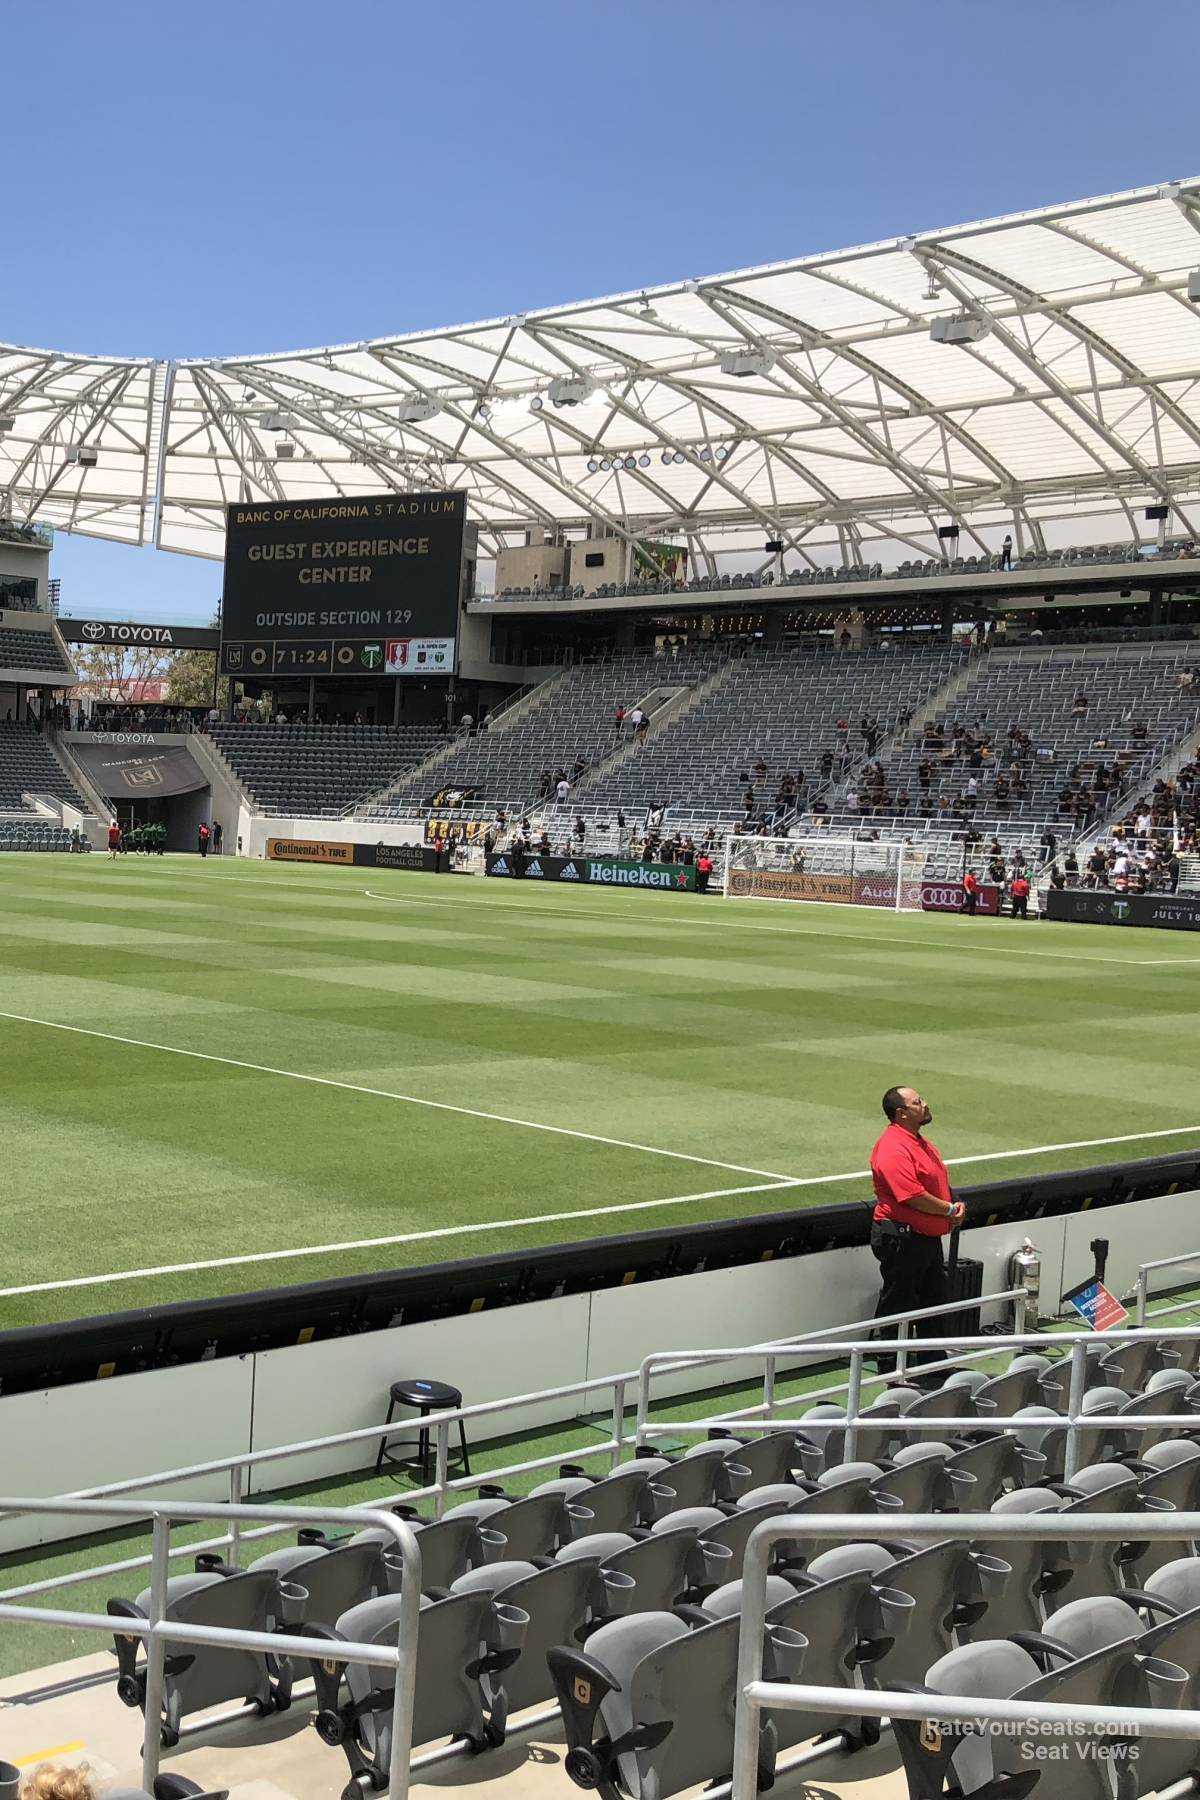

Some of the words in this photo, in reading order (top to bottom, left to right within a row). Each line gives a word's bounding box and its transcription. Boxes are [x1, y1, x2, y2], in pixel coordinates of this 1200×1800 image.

[236, 510, 271, 524] BANC
[274, 509, 291, 522] OF
[293, 504, 370, 521] CALIFORNIA
[374, 500, 456, 516] STADIUM
[247, 543, 307, 561] GUEST
[310, 538, 431, 559] EXPERIENCE
[298, 565, 373, 584] CENTER
[255, 611, 316, 627] OUTSIDE
[319, 610, 382, 626] SECTION
[385, 608, 413, 624] 129
[108, 625, 173, 642] TOYOTA
[276, 649, 328, 664] 71:24
[444, 694, 457, 703] 101
[110, 733, 156, 744] TOYOTA
[273, 841, 320, 856] Continental
[328, 848, 347, 858] TIRE
[375, 847, 391, 857] LOS
[391, 848, 424, 859] ANGELES
[375, 856, 407, 866] FOOTBALL
[407, 858, 424, 867] CLUB
[491, 867, 510, 875] adidas
[524, 869, 544, 877] adidas
[559, 872, 580, 880] adidas
[589, 863, 671, 886] Heineken
[1151, 910, 1182, 920] JULY
[578, 1684, 587, 1698] C
